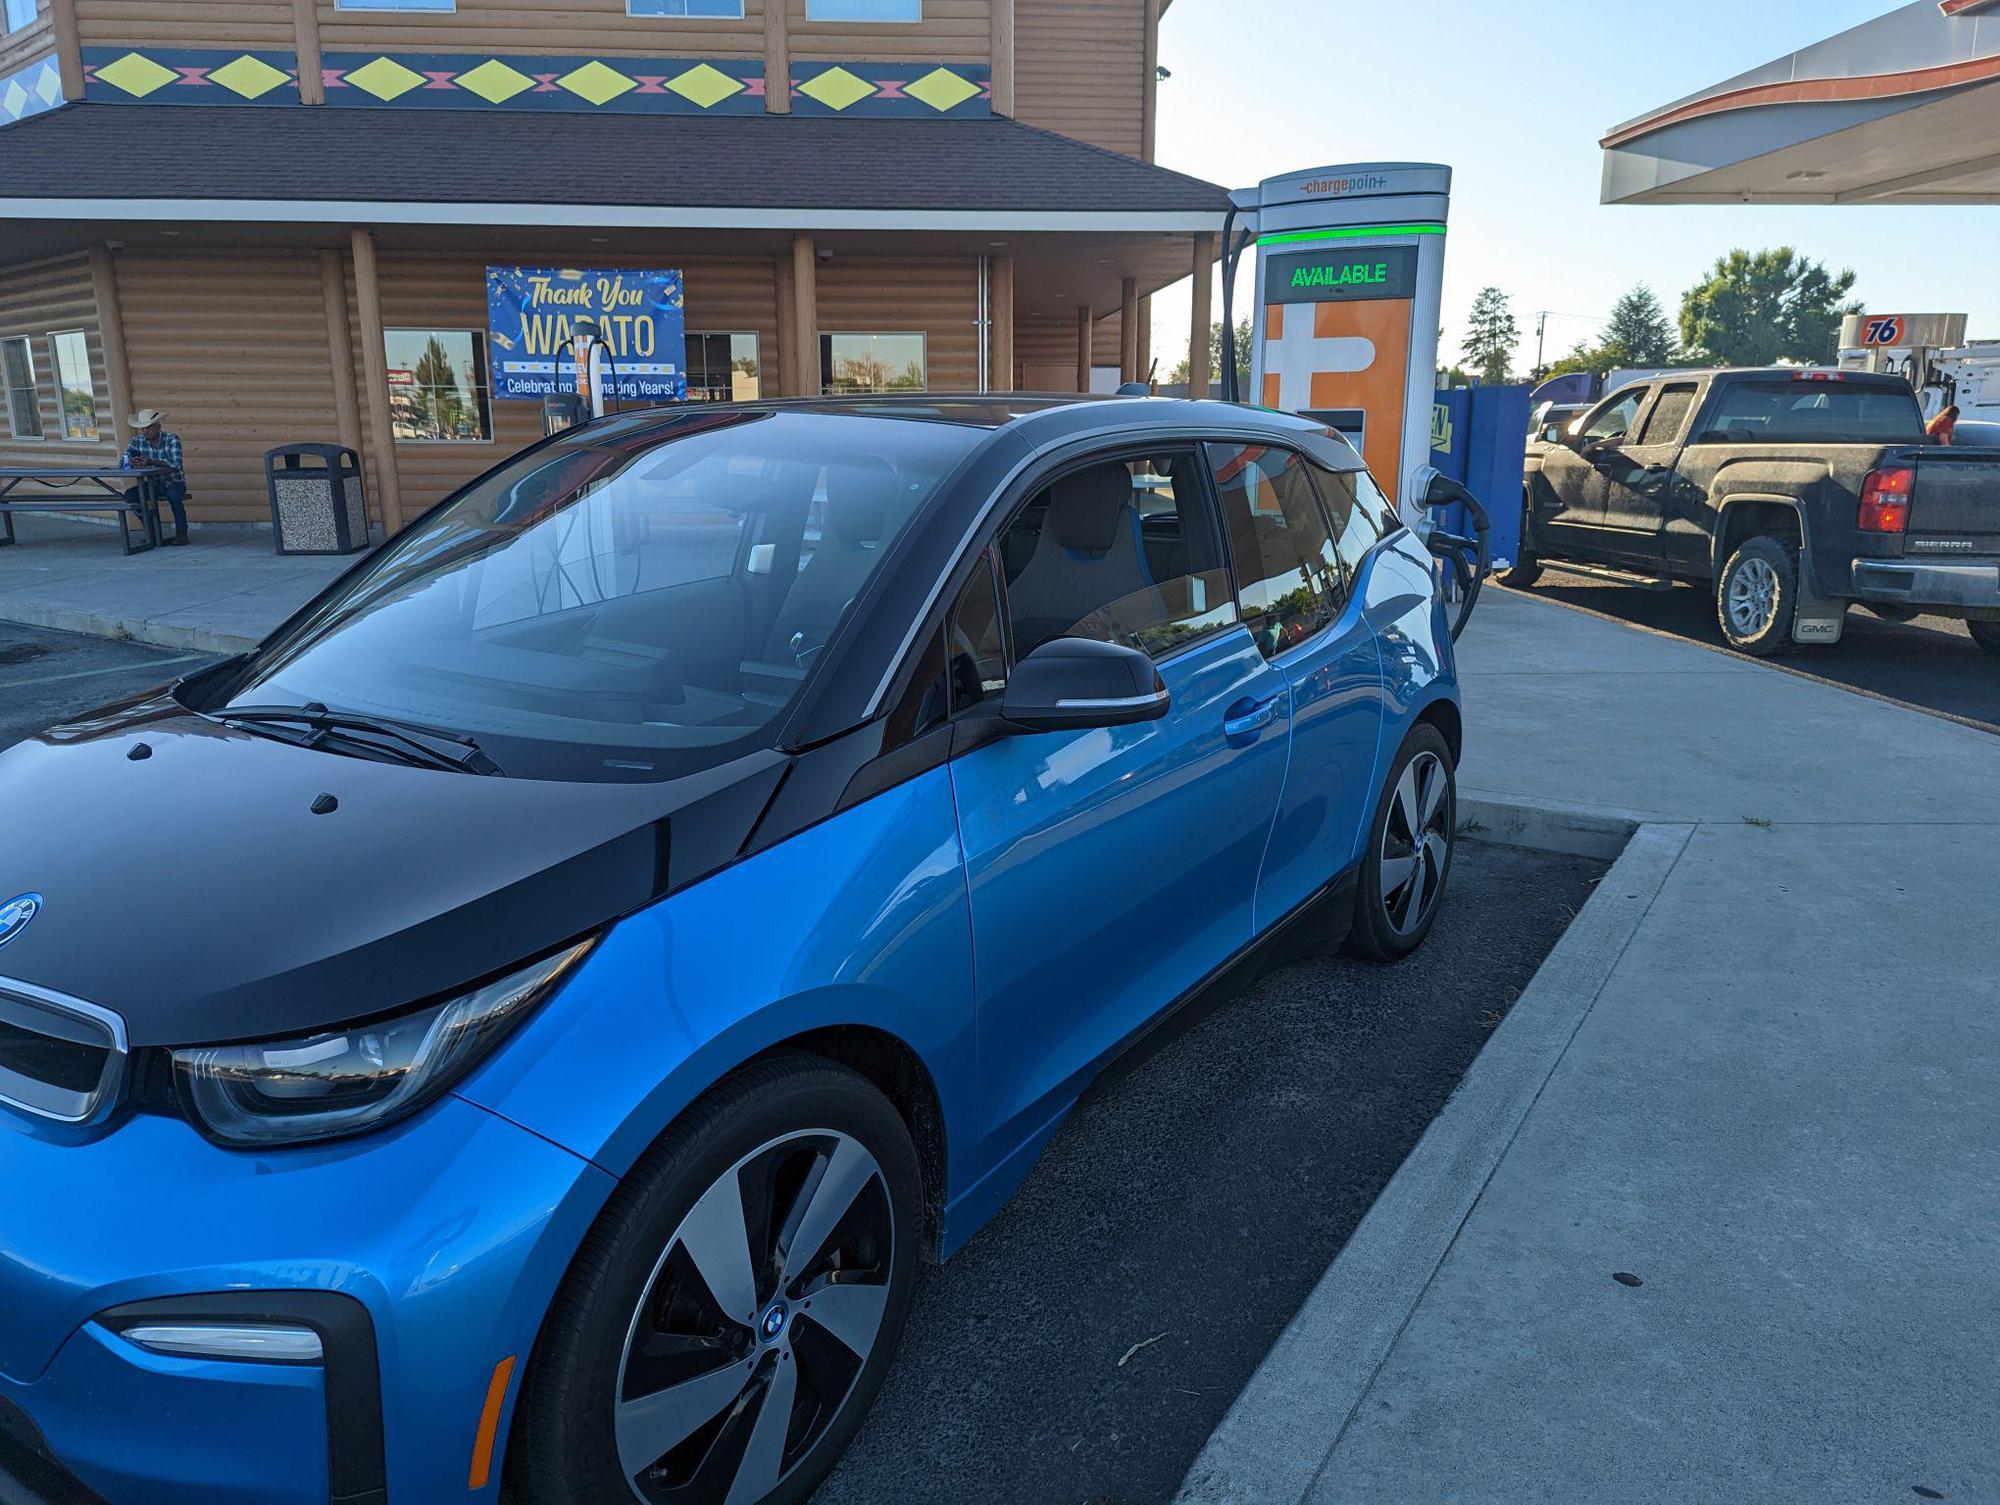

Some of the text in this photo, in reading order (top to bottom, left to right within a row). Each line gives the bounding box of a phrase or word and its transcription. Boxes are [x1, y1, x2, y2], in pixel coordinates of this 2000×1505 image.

[1291, 263, 1387, 287] AVAILABLE
[528, 276, 644, 312] Thank You
[1865, 318, 1898, 344] 76
[507, 378, 573, 394] Celebratng
[638, 380, 674, 395] Years!
[1914, 540, 1973, 549] SIERRA
[1801, 624, 1834, 633] GMC
